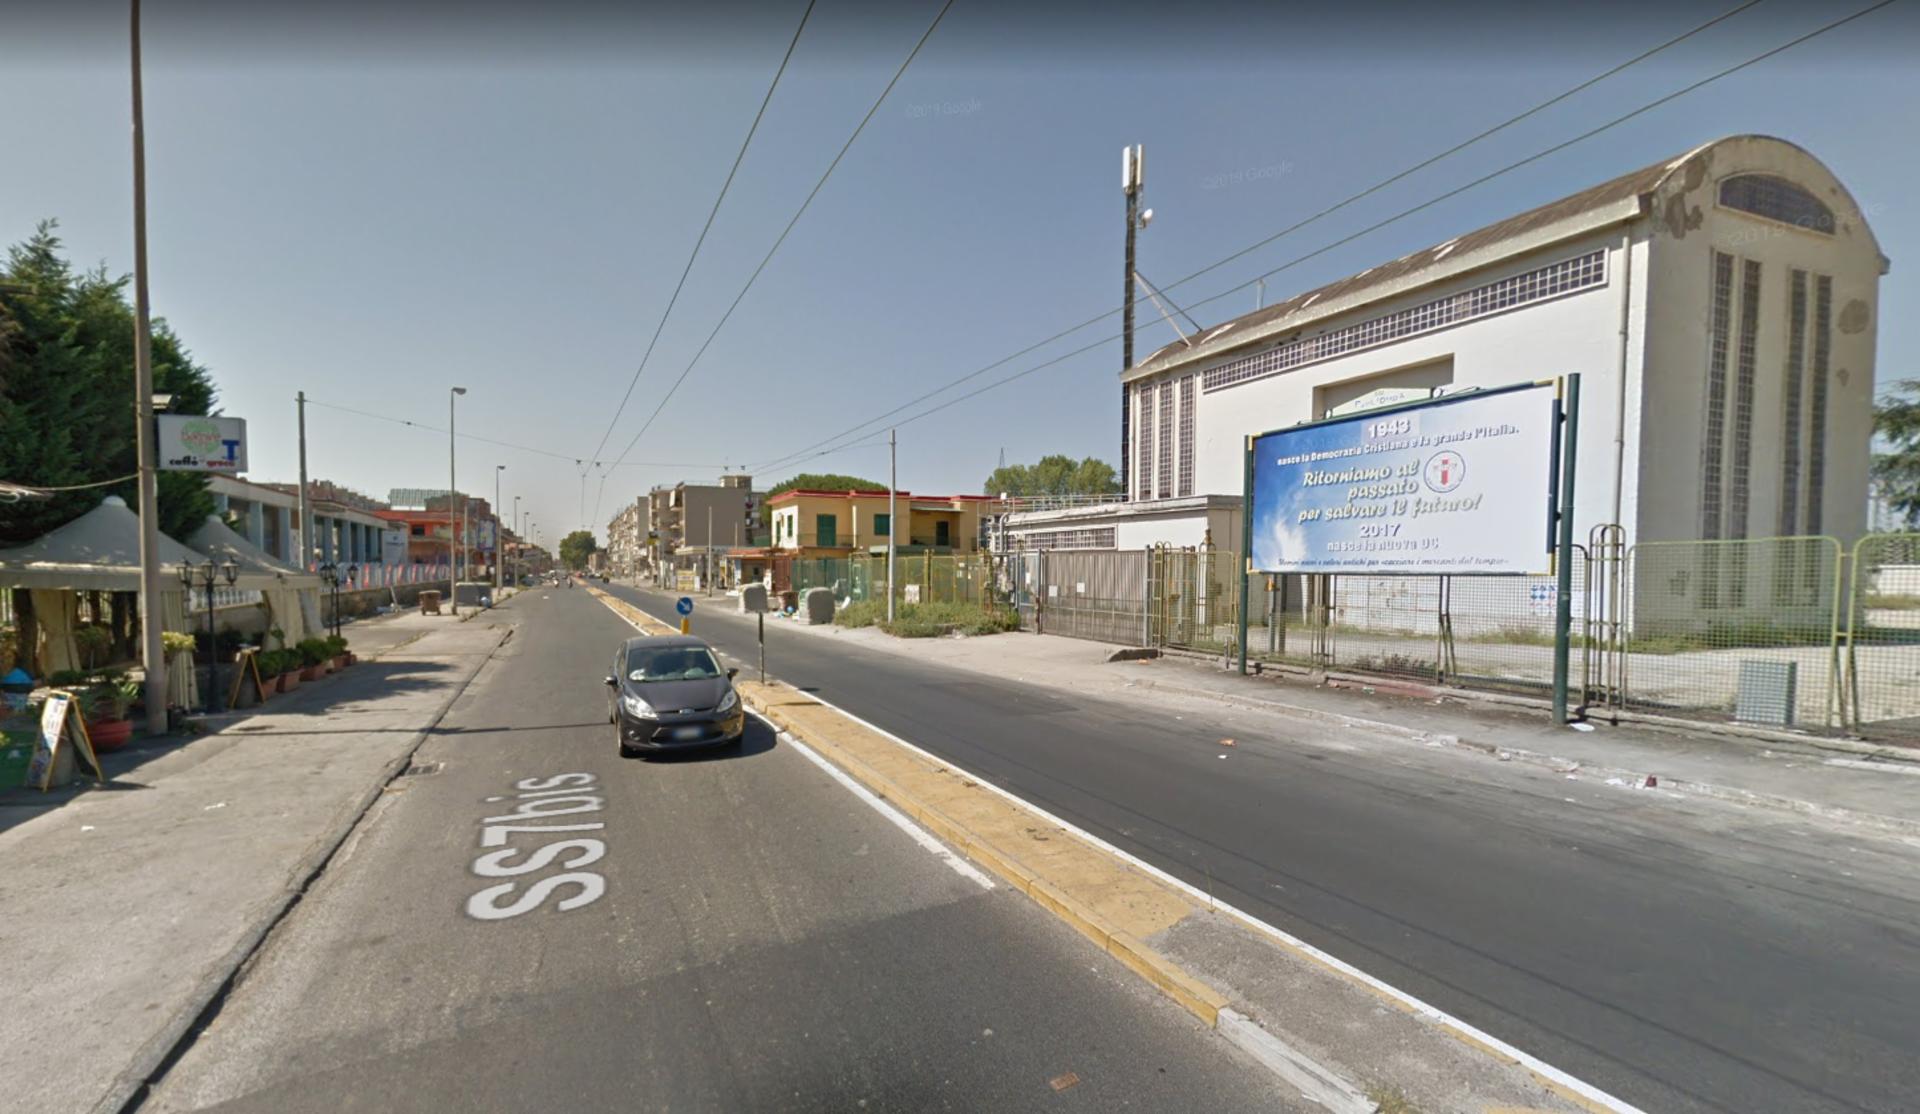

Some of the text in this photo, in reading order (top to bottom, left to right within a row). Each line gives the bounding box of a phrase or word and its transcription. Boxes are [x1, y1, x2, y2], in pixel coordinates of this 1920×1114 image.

[1368, 418, 1410, 439] 1943
[1277, 455, 1300, 467] nasce
[1301, 453, 1310, 464] la
[1311, 446, 1362, 461] Democrazia
[1364, 440, 1410, 455] Cristiana
[1420, 435, 1431, 447] la
[1433, 431, 1473, 447] grande
[1303, 464, 1392, 488] Ritorniamo
[1396, 458, 1421, 479] al
[1347, 477, 1420, 502] passato
[1298, 493, 1484, 525] per salvare il futuro!
[1360, 523, 1402, 539] 2017
[1327, 540, 1362, 553] nasce
[1364, 539, 1377, 552] la
[1379, 538, 1418, 552] nuova
